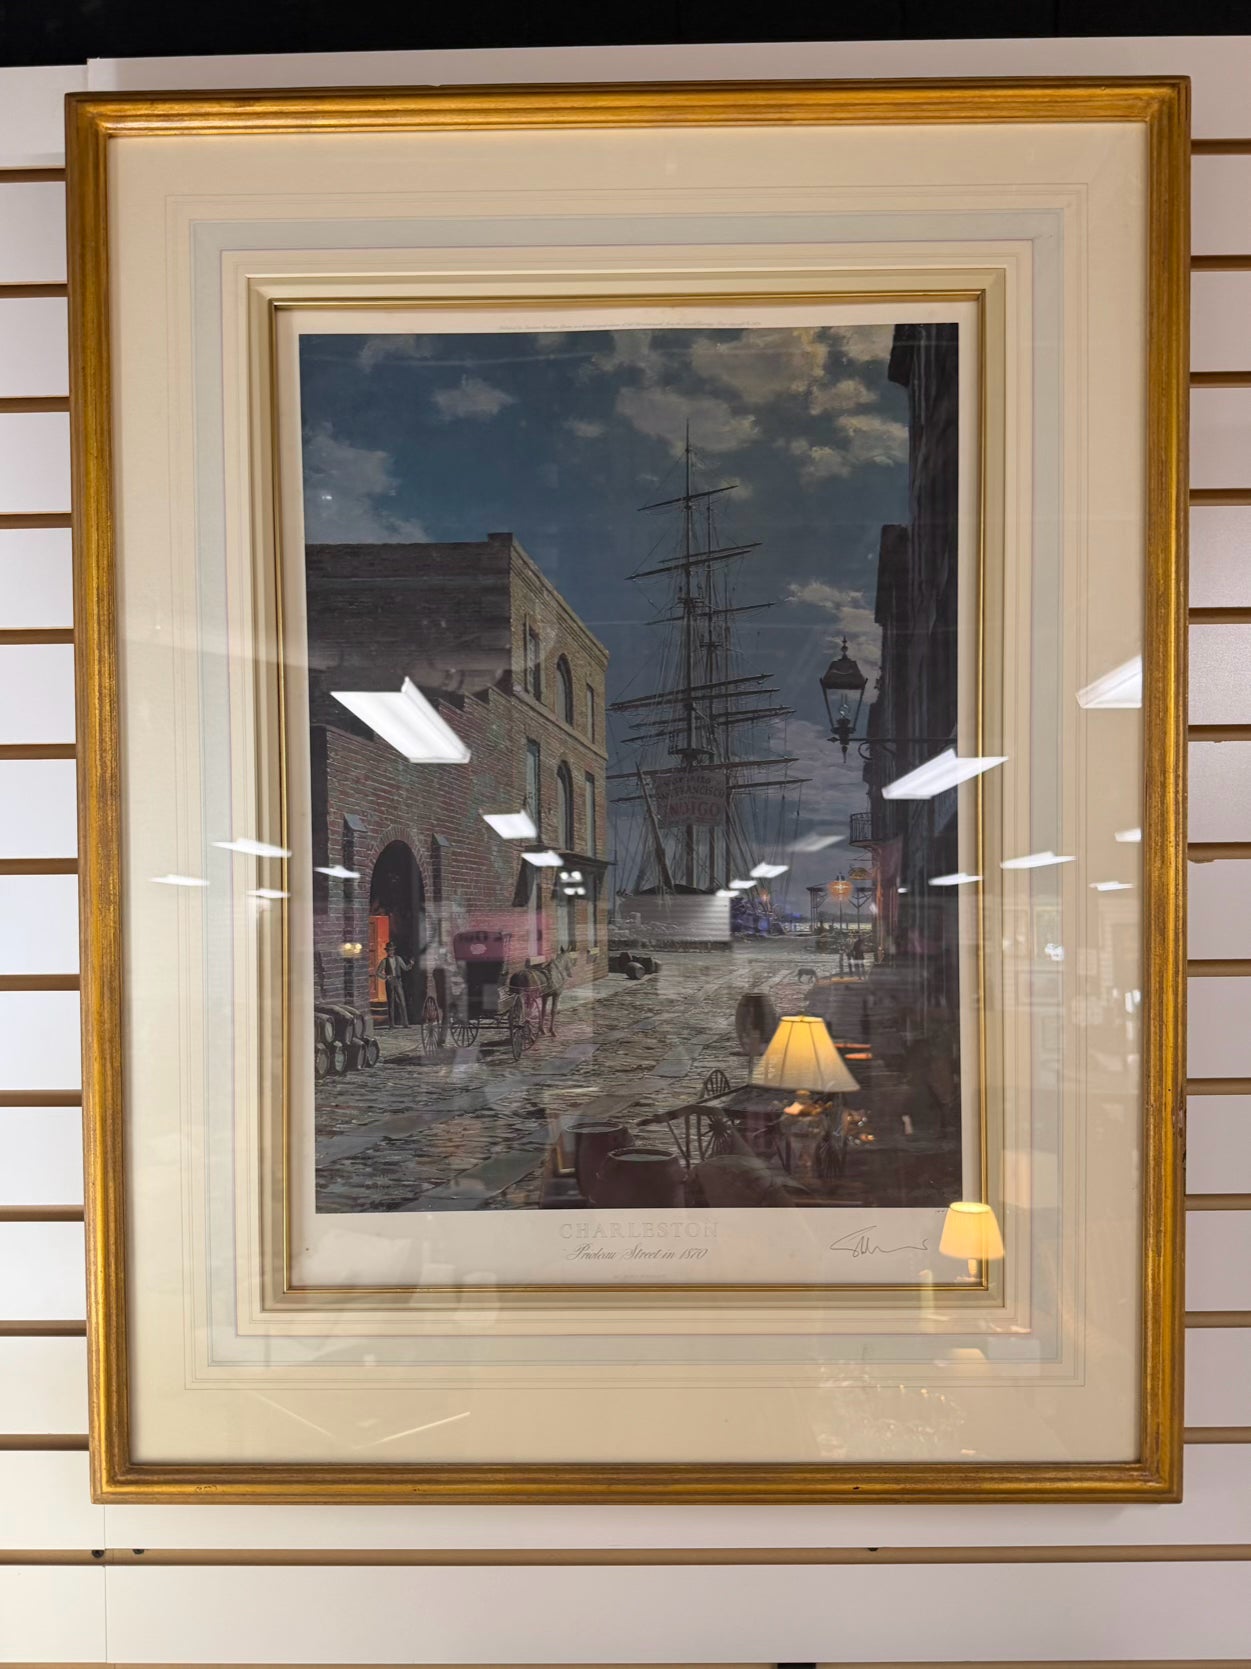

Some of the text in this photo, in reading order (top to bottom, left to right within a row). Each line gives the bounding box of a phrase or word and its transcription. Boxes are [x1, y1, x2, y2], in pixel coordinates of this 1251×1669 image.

[559, 1222, 719, 1239] CHARLESTON
[619, 1243, 661, 1261] Street
[661, 1251, 676, 1260] in
[678, 1248, 709, 1261] 1870
